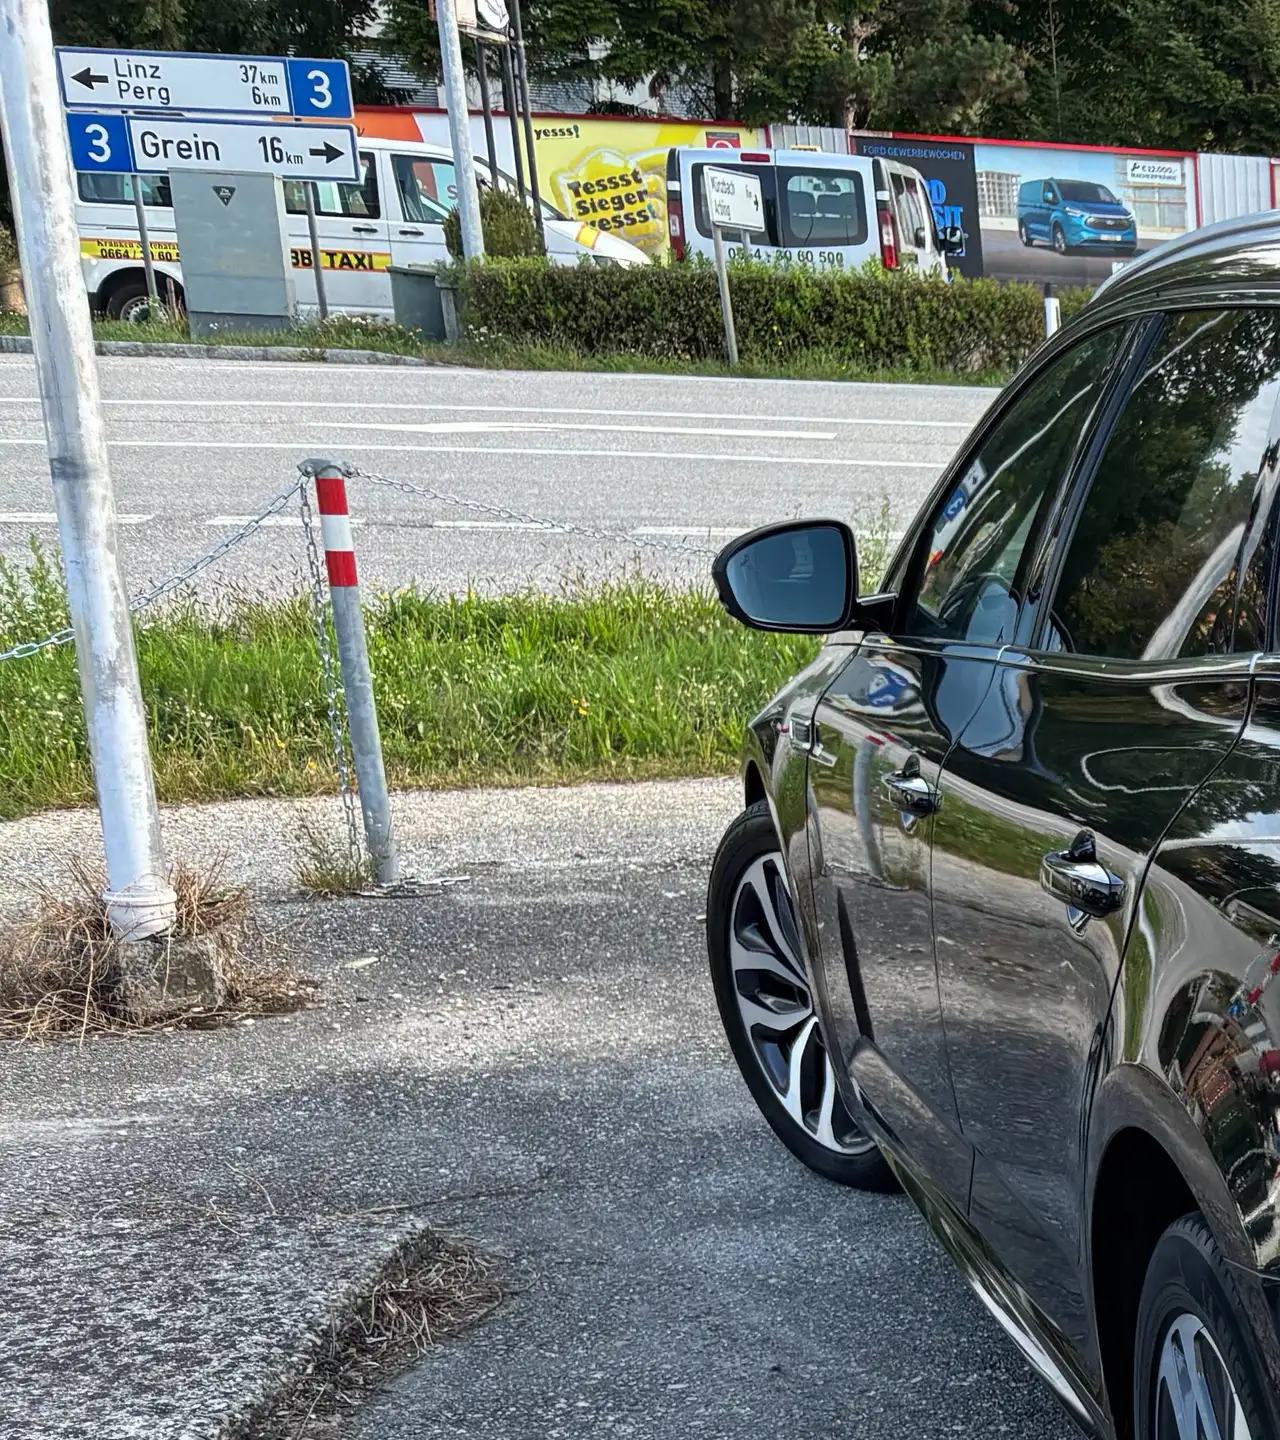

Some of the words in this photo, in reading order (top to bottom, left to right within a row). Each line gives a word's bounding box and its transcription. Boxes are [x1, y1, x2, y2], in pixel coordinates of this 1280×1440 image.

[113, 58, 161, 79] Linz
[307, 70, 332, 108] 3
[117, 80, 170, 105] Perg
[85, 124, 111, 162] 3
[140, 131, 220, 161] Grein
[534, 125, 580, 140] yesss!
[863, 145, 886, 155] FORD
[888, 147, 965, 160] GEWERBEWOCHEN
[567, 168, 643, 198] Tessst
[574, 188, 648, 216] Sieger
[100, 248, 129, 259] 0664
[326, 252, 374, 270] TAXI
